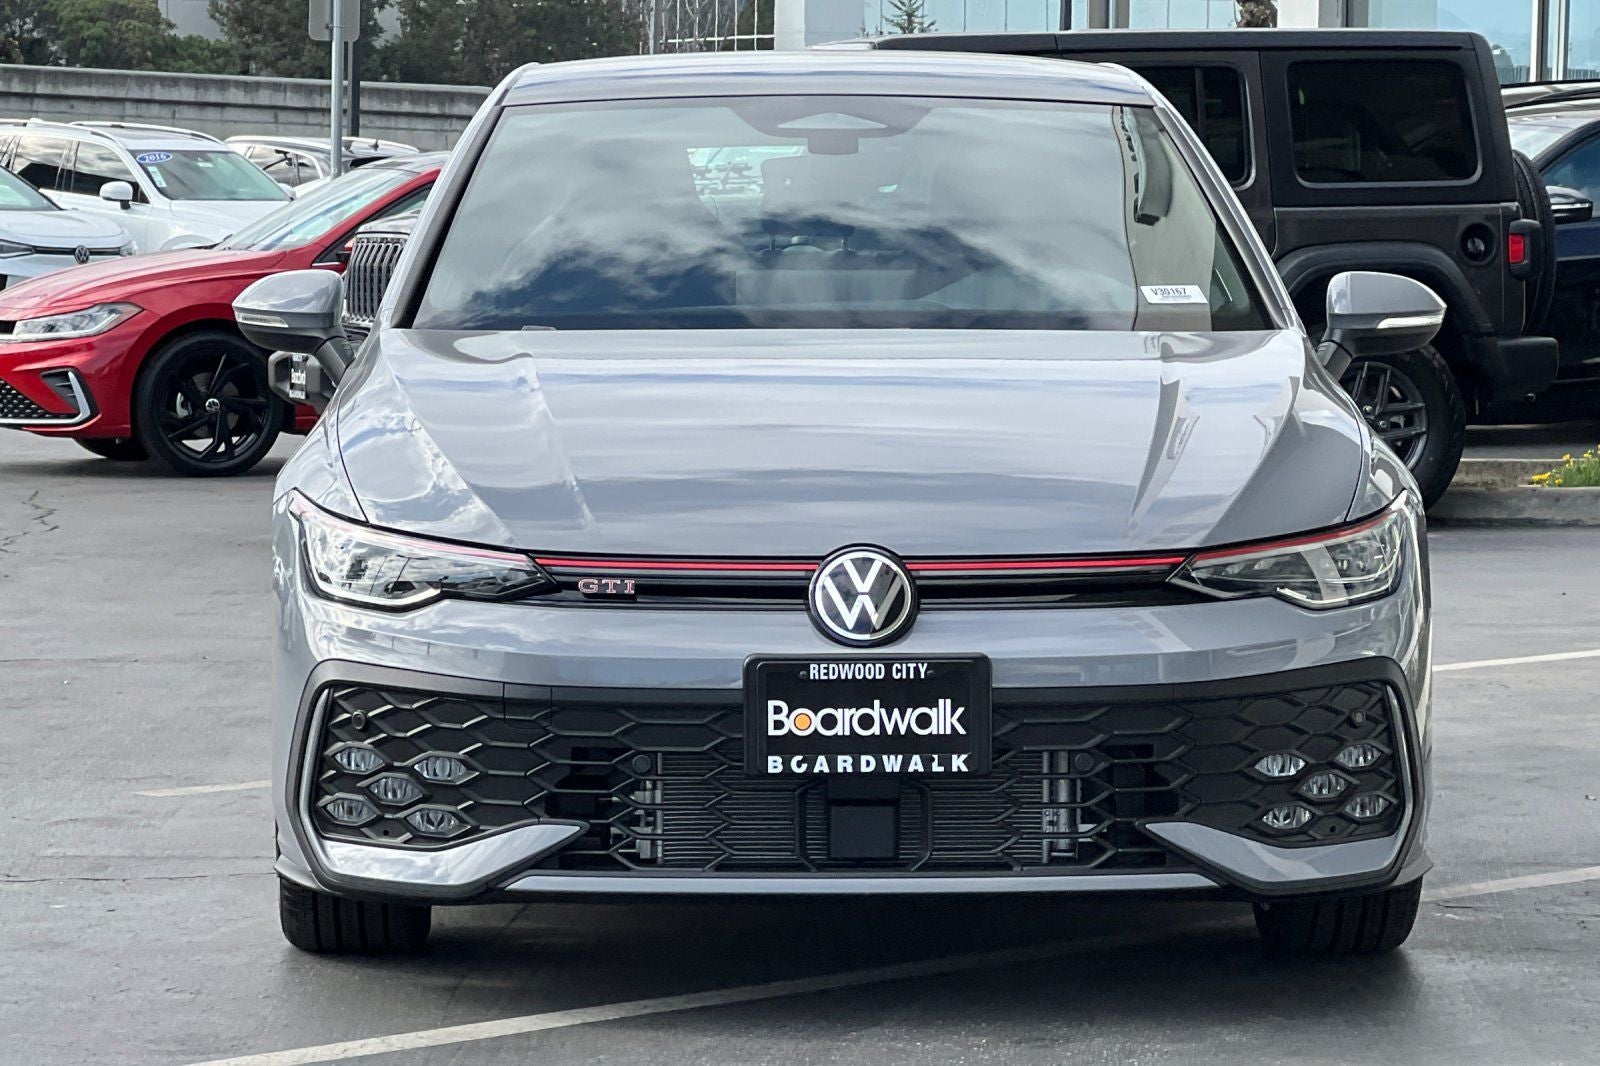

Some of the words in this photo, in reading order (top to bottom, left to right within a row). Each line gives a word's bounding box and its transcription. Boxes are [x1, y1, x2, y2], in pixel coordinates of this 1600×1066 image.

[143, 153, 167, 162] 2016
[1150, 287, 1186, 295] V30167
[578, 578, 635, 594] GTI
[809, 663, 885, 680] REDWOOD
[892, 663, 928, 679] CITY
[767, 698, 967, 737] Boardwalk
